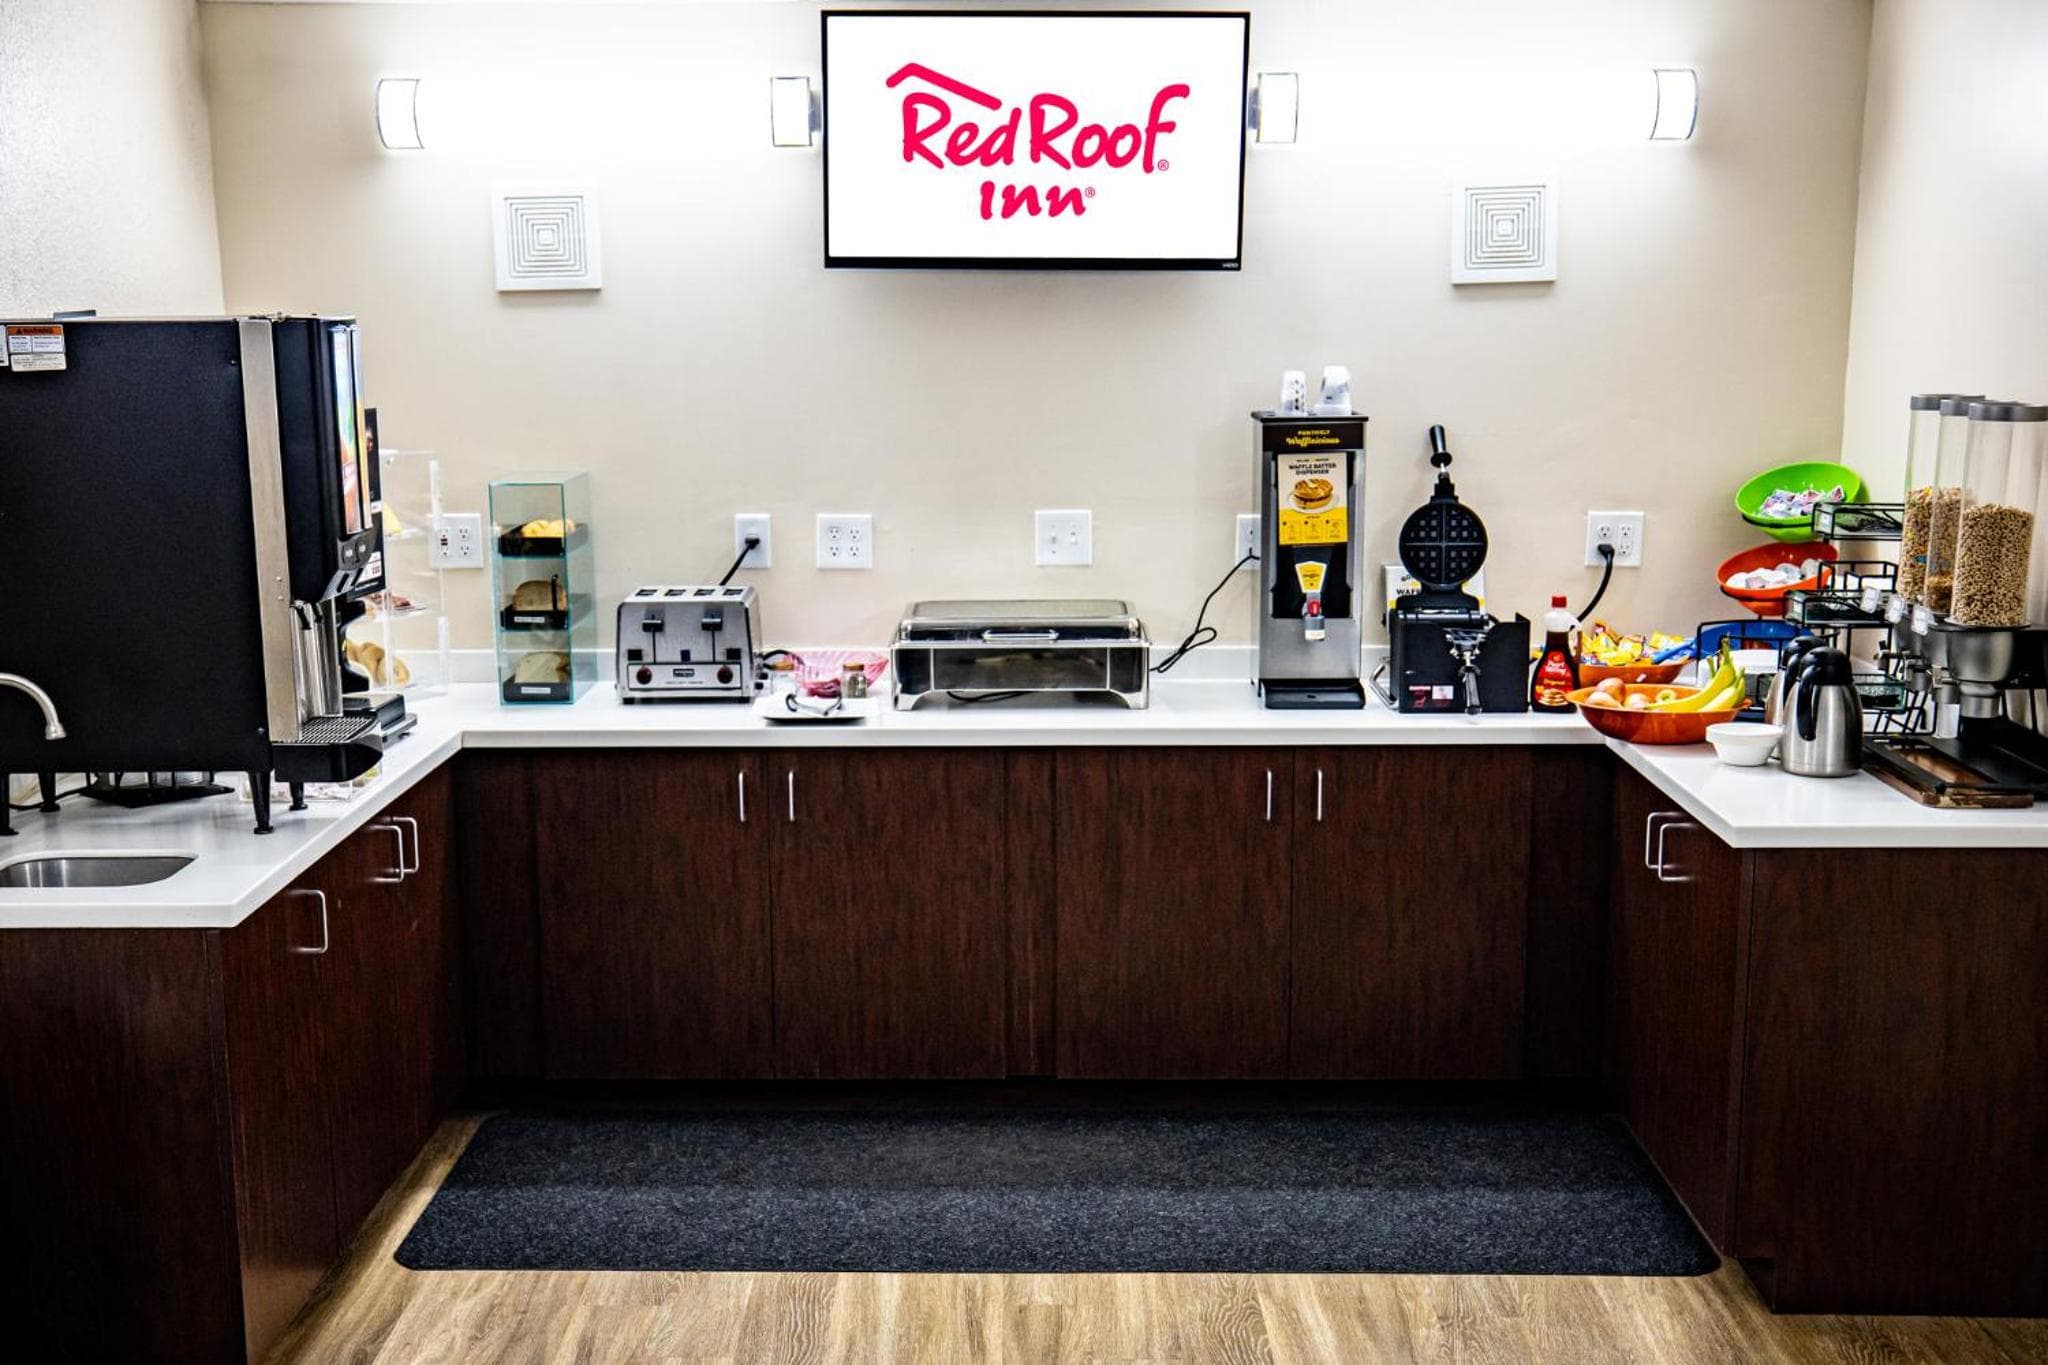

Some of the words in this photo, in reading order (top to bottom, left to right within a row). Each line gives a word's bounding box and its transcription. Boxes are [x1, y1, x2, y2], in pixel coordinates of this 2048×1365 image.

[902, 92, 1022, 169] Red
[1030, 84, 1191, 174] Roof
[979, 180, 1087, 221] Inn
